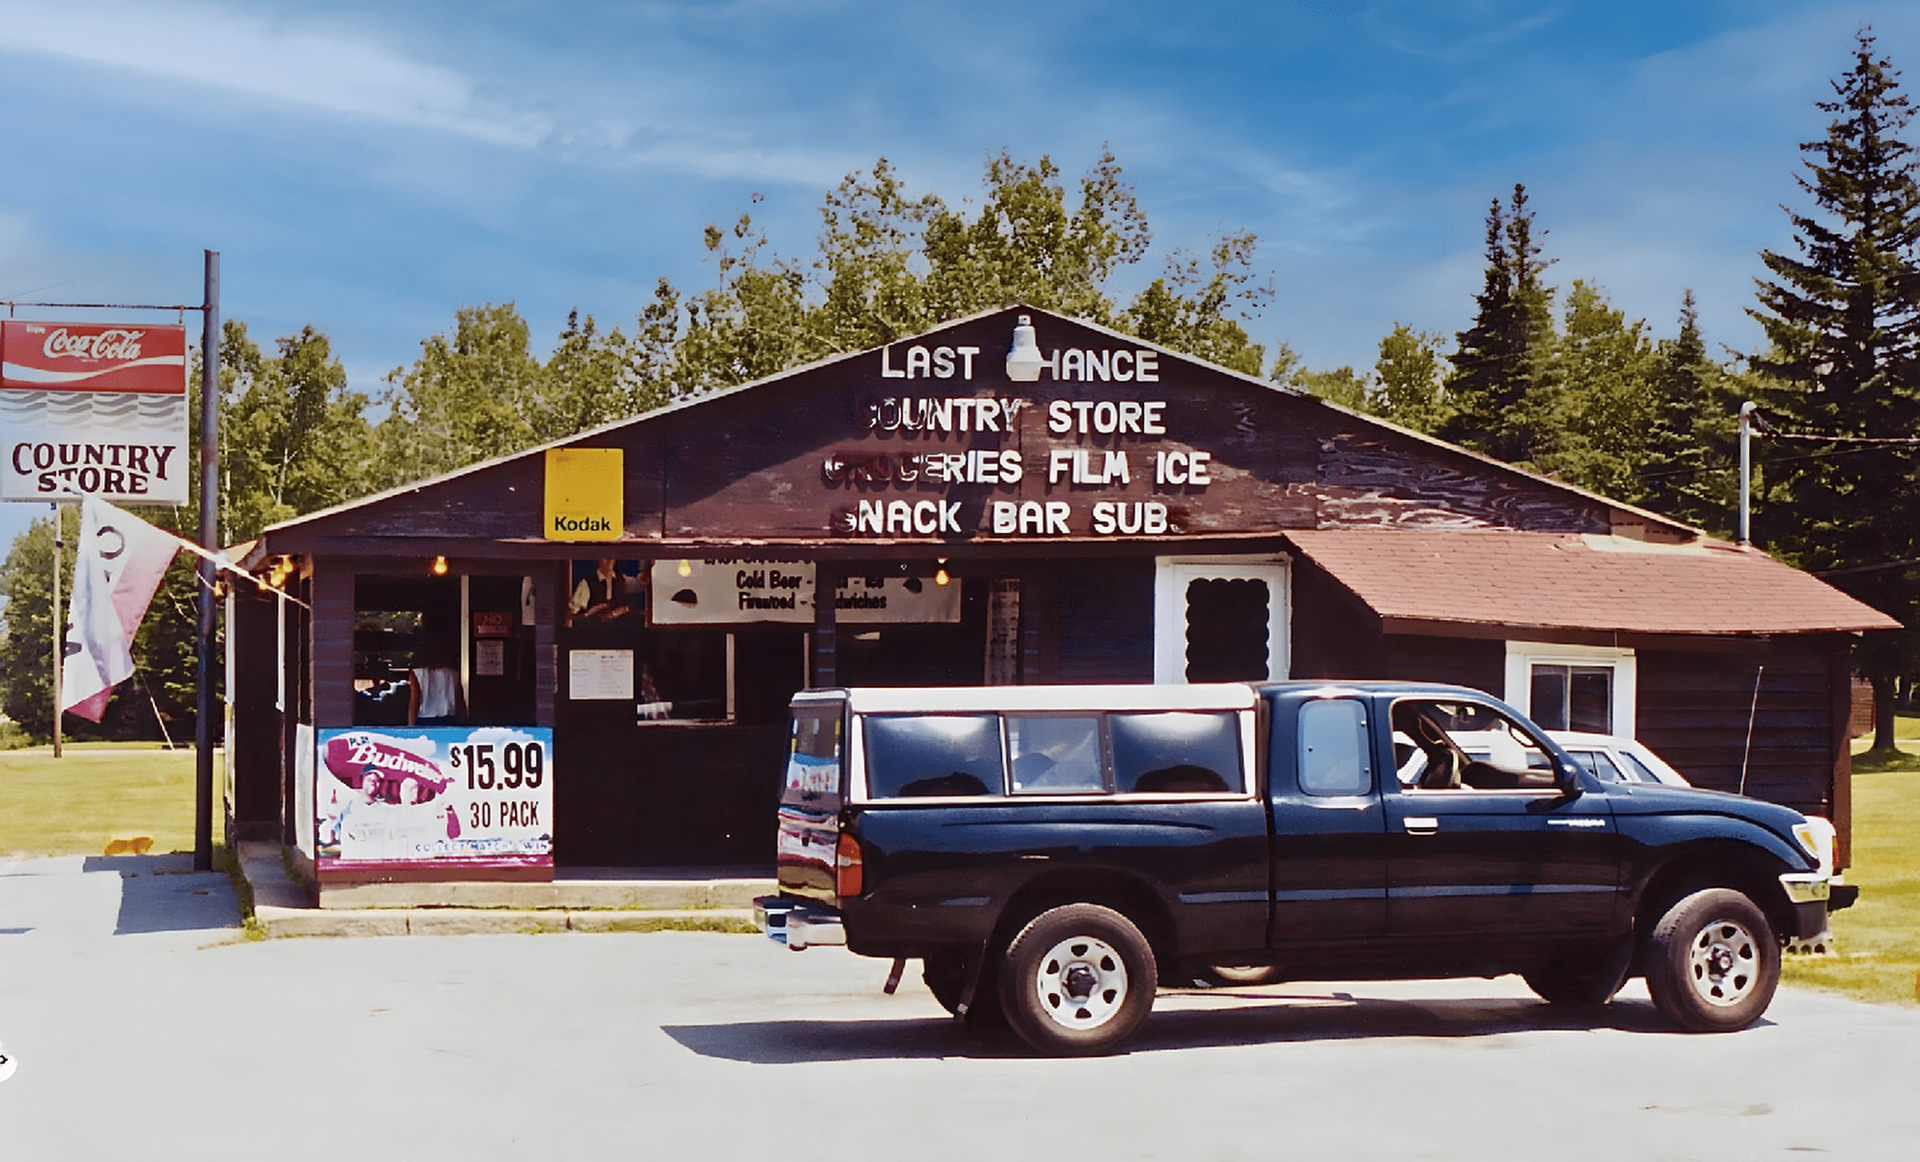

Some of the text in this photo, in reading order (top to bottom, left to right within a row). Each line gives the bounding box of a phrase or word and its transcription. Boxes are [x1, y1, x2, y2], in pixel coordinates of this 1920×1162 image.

[881, 345, 1160, 381] LAST HANCE
[867, 397, 1167, 434] OUNTRY STORE
[12, 442, 176, 481] COUNTRY
[1050, 450, 1131, 484] FILM
[1156, 451, 1211, 485] ICE
[38, 467, 148, 494] STORE
[555, 516, 611, 532] Kodak
[993, 501, 1071, 534] BAR
[736, 569, 765, 589] Cold
[450, 742, 543, 790] $15.99
[470, 801, 539, 829] 30 PACK
